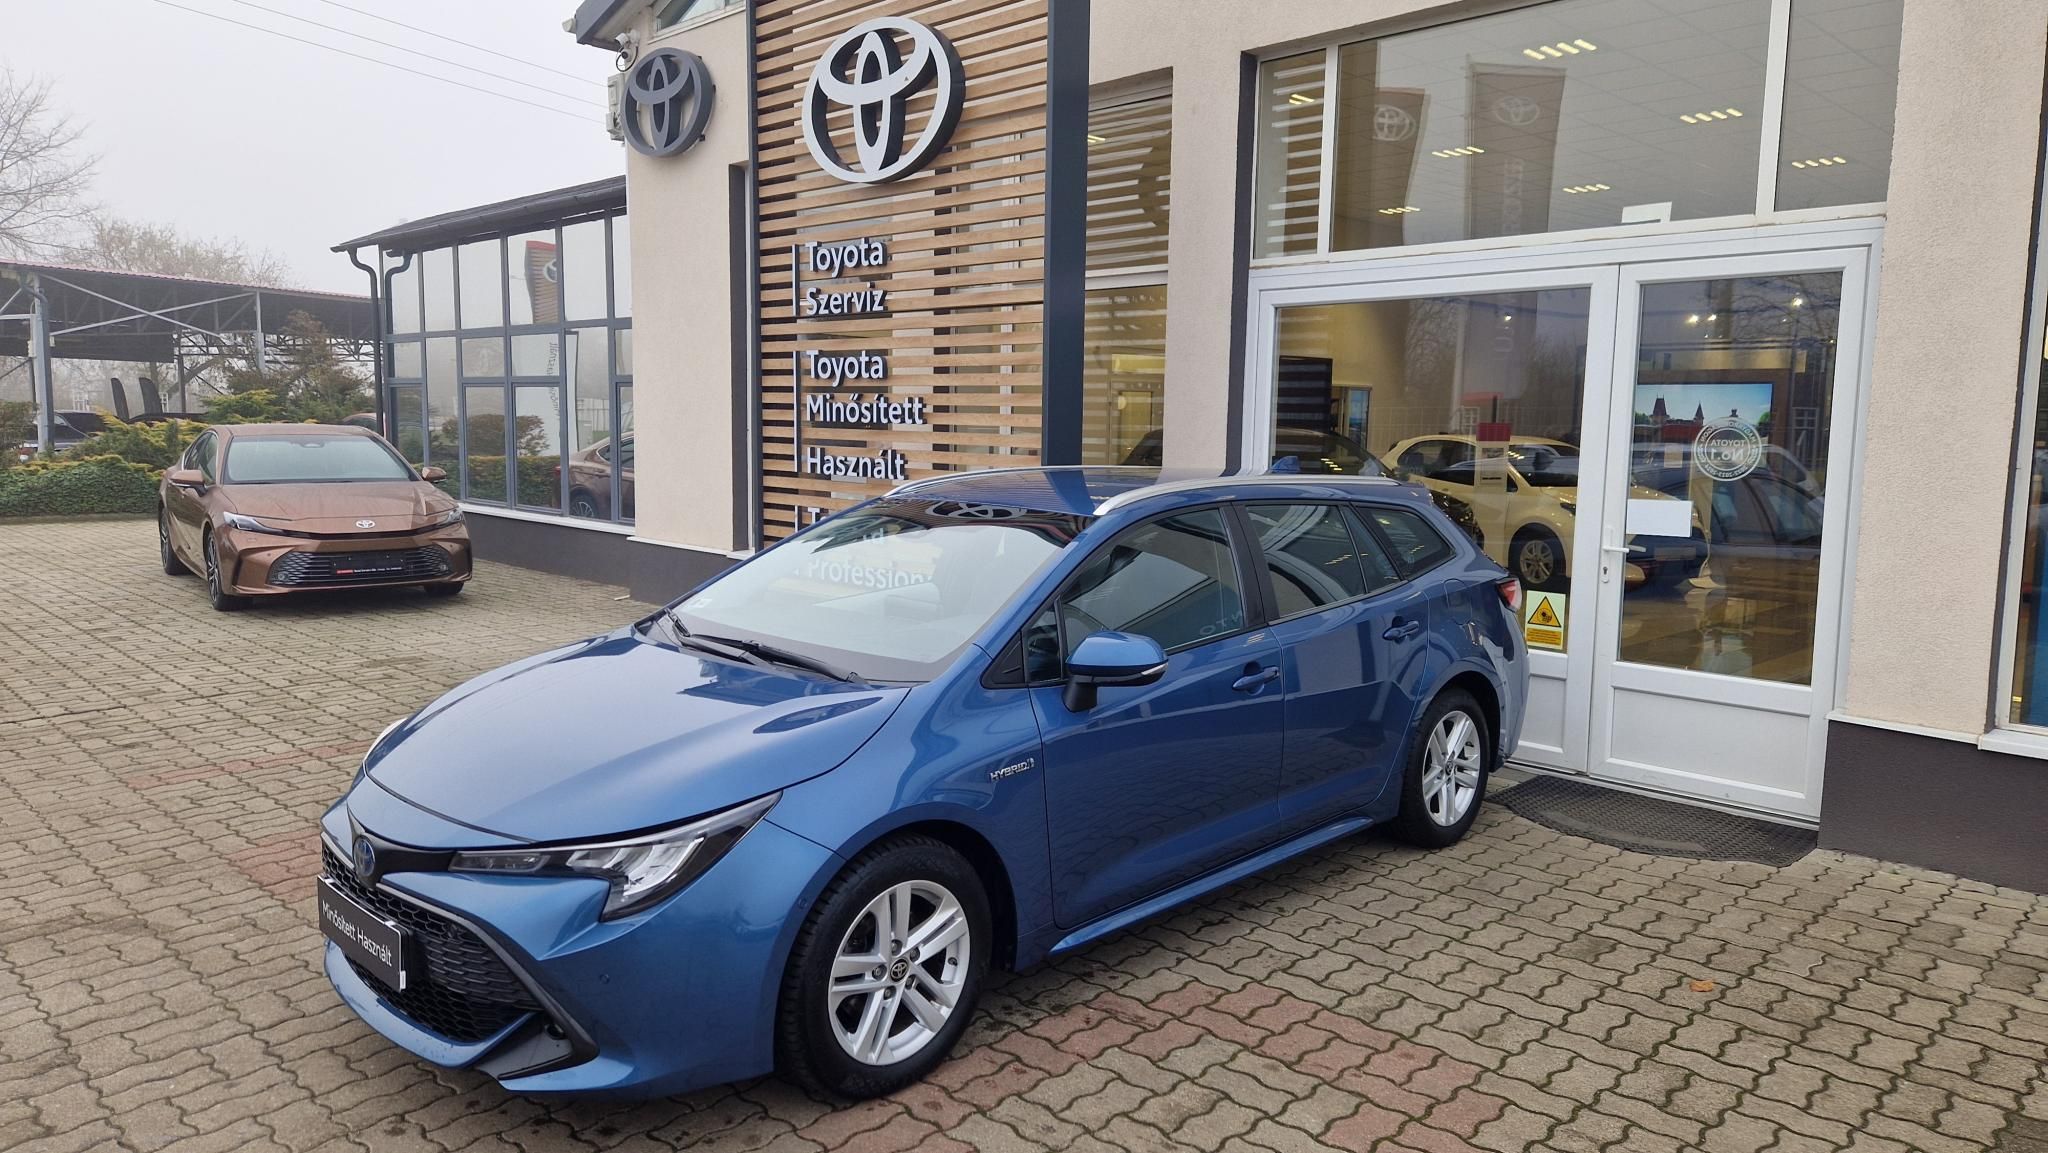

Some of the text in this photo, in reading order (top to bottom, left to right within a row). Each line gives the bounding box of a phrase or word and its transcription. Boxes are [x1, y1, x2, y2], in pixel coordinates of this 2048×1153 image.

[805, 238, 885, 277] Toyota
[806, 283, 885, 315] Szerviz
[806, 350, 885, 386] Toyota
[806, 393, 925, 425] Minősített
[806, 447, 906, 480] Használt
[990, 761, 1029, 781] HYBRID
[322, 900, 392, 967] Minősített Használt
